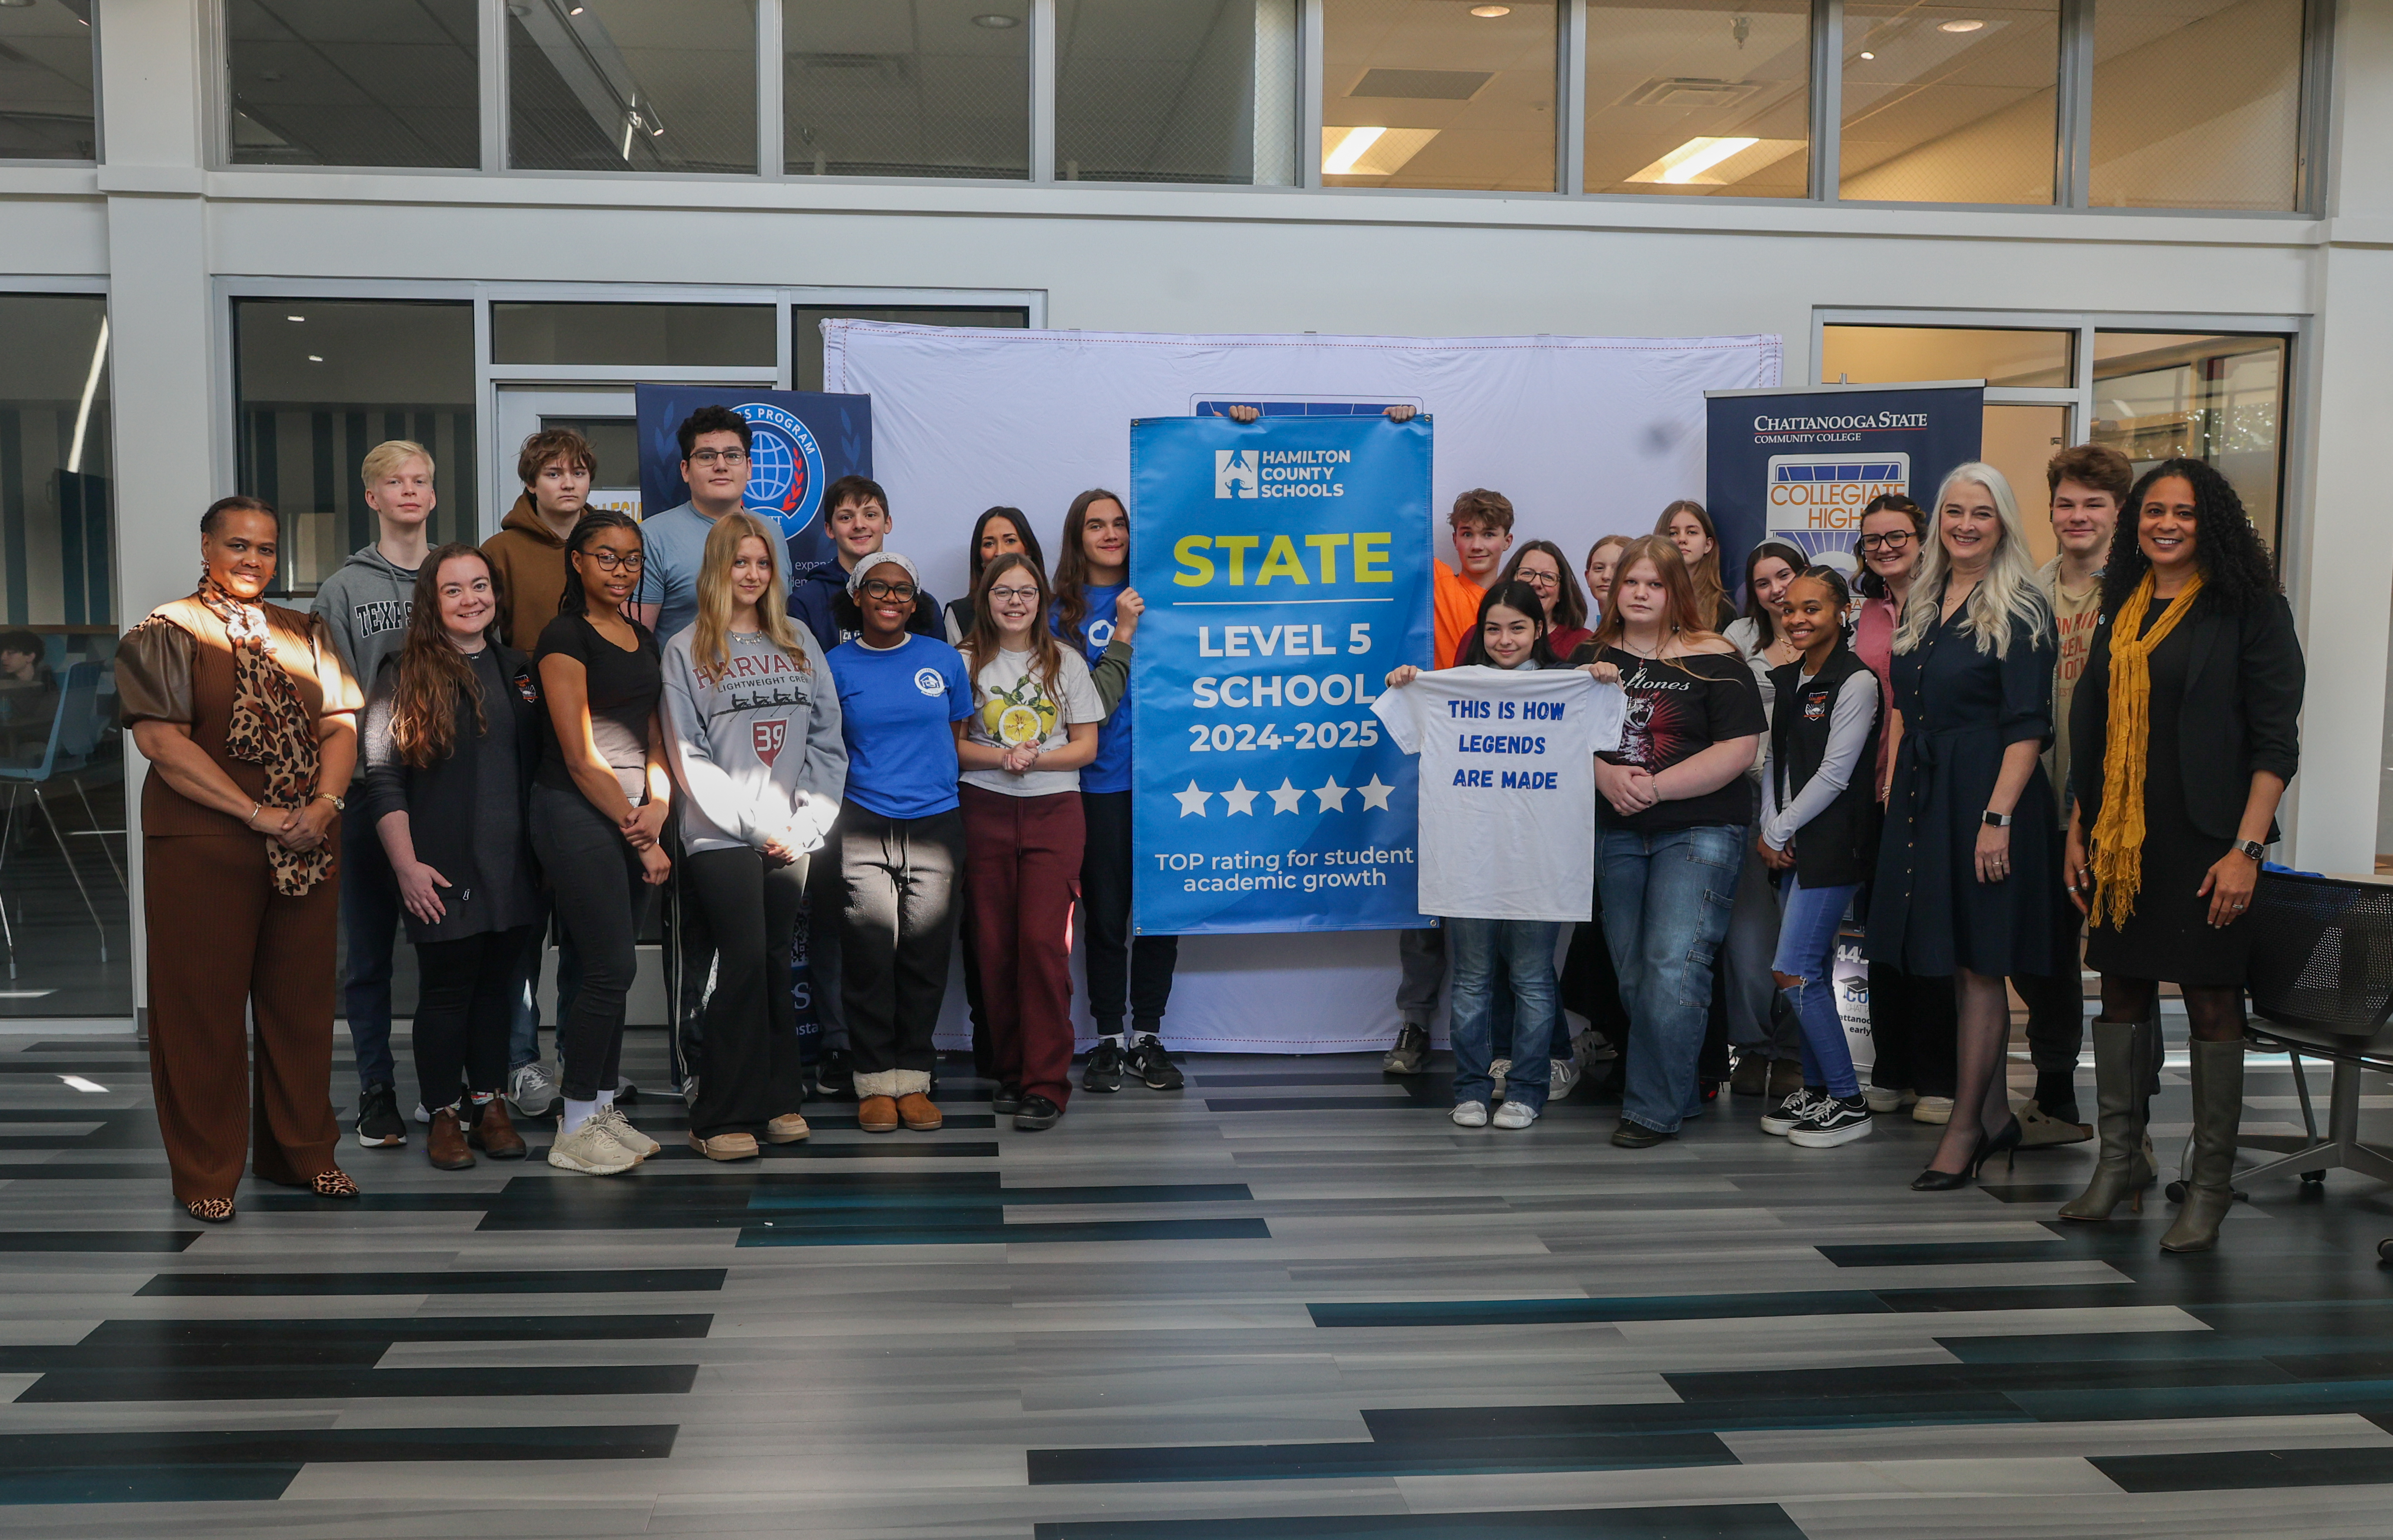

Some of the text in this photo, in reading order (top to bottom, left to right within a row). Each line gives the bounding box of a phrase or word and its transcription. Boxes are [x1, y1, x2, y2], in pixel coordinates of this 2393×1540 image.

[757, 407, 816, 454] PROGRAM
[1754, 411, 1927, 431] CHATTANOOGA STATE
[1754, 432, 1861, 444] COMMUNITY COLLEGE
[1262, 449, 1350, 464] HAMILTON
[1261, 467, 1334, 480] COUNTY
[1261, 483, 1344, 497] SCHOOLS
[1173, 532, 1393, 587] STATE
[1199, 623, 1371, 657] LEVEL 5
[718, 676, 785, 693] LIGHTWEIGHT
[1192, 673, 1376, 708] SCHOOL
[1448, 700, 1565, 720] THIS IS HOW
[756, 725, 784, 751] 39
[1188, 720, 1378, 751] 2024-2025
[1458, 734, 1546, 754] LEGENDS
[1452, 769, 1558, 790] ARE MADE
[1155, 846, 1414, 872] TOP rating for student
[1184, 868, 1386, 893] academic growth
[1850, 1026, 1871, 1037] early
